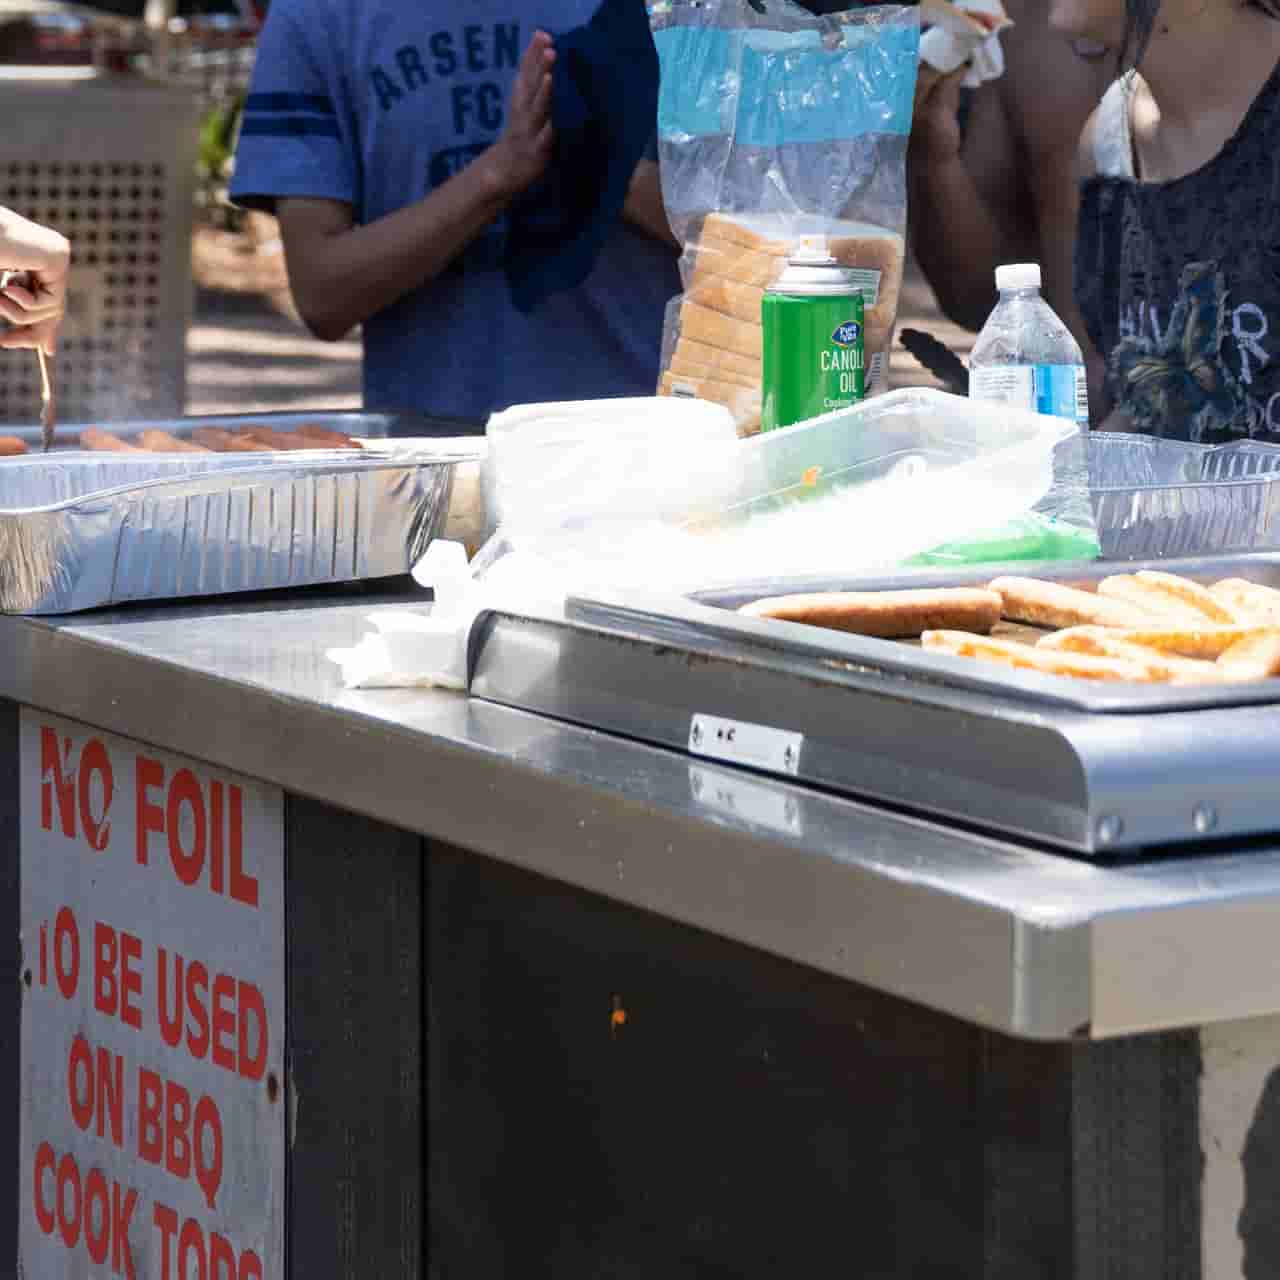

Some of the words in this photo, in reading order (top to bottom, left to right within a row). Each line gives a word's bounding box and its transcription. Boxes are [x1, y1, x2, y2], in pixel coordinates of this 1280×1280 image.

[369, 23, 520, 111] ARSEN
[451, 82, 503, 134] FC
[840, 372, 858, 393] OIL
[40, 726, 113, 851] NO
[135, 754, 259, 908] FOIL
[94, 921, 142, 1030] BE
[157, 946, 269, 1082] USED
[67, 1035, 123, 1148] ON
[138, 1065, 223, 1209] BBQ
[33, 1140, 140, 1280] COOK
